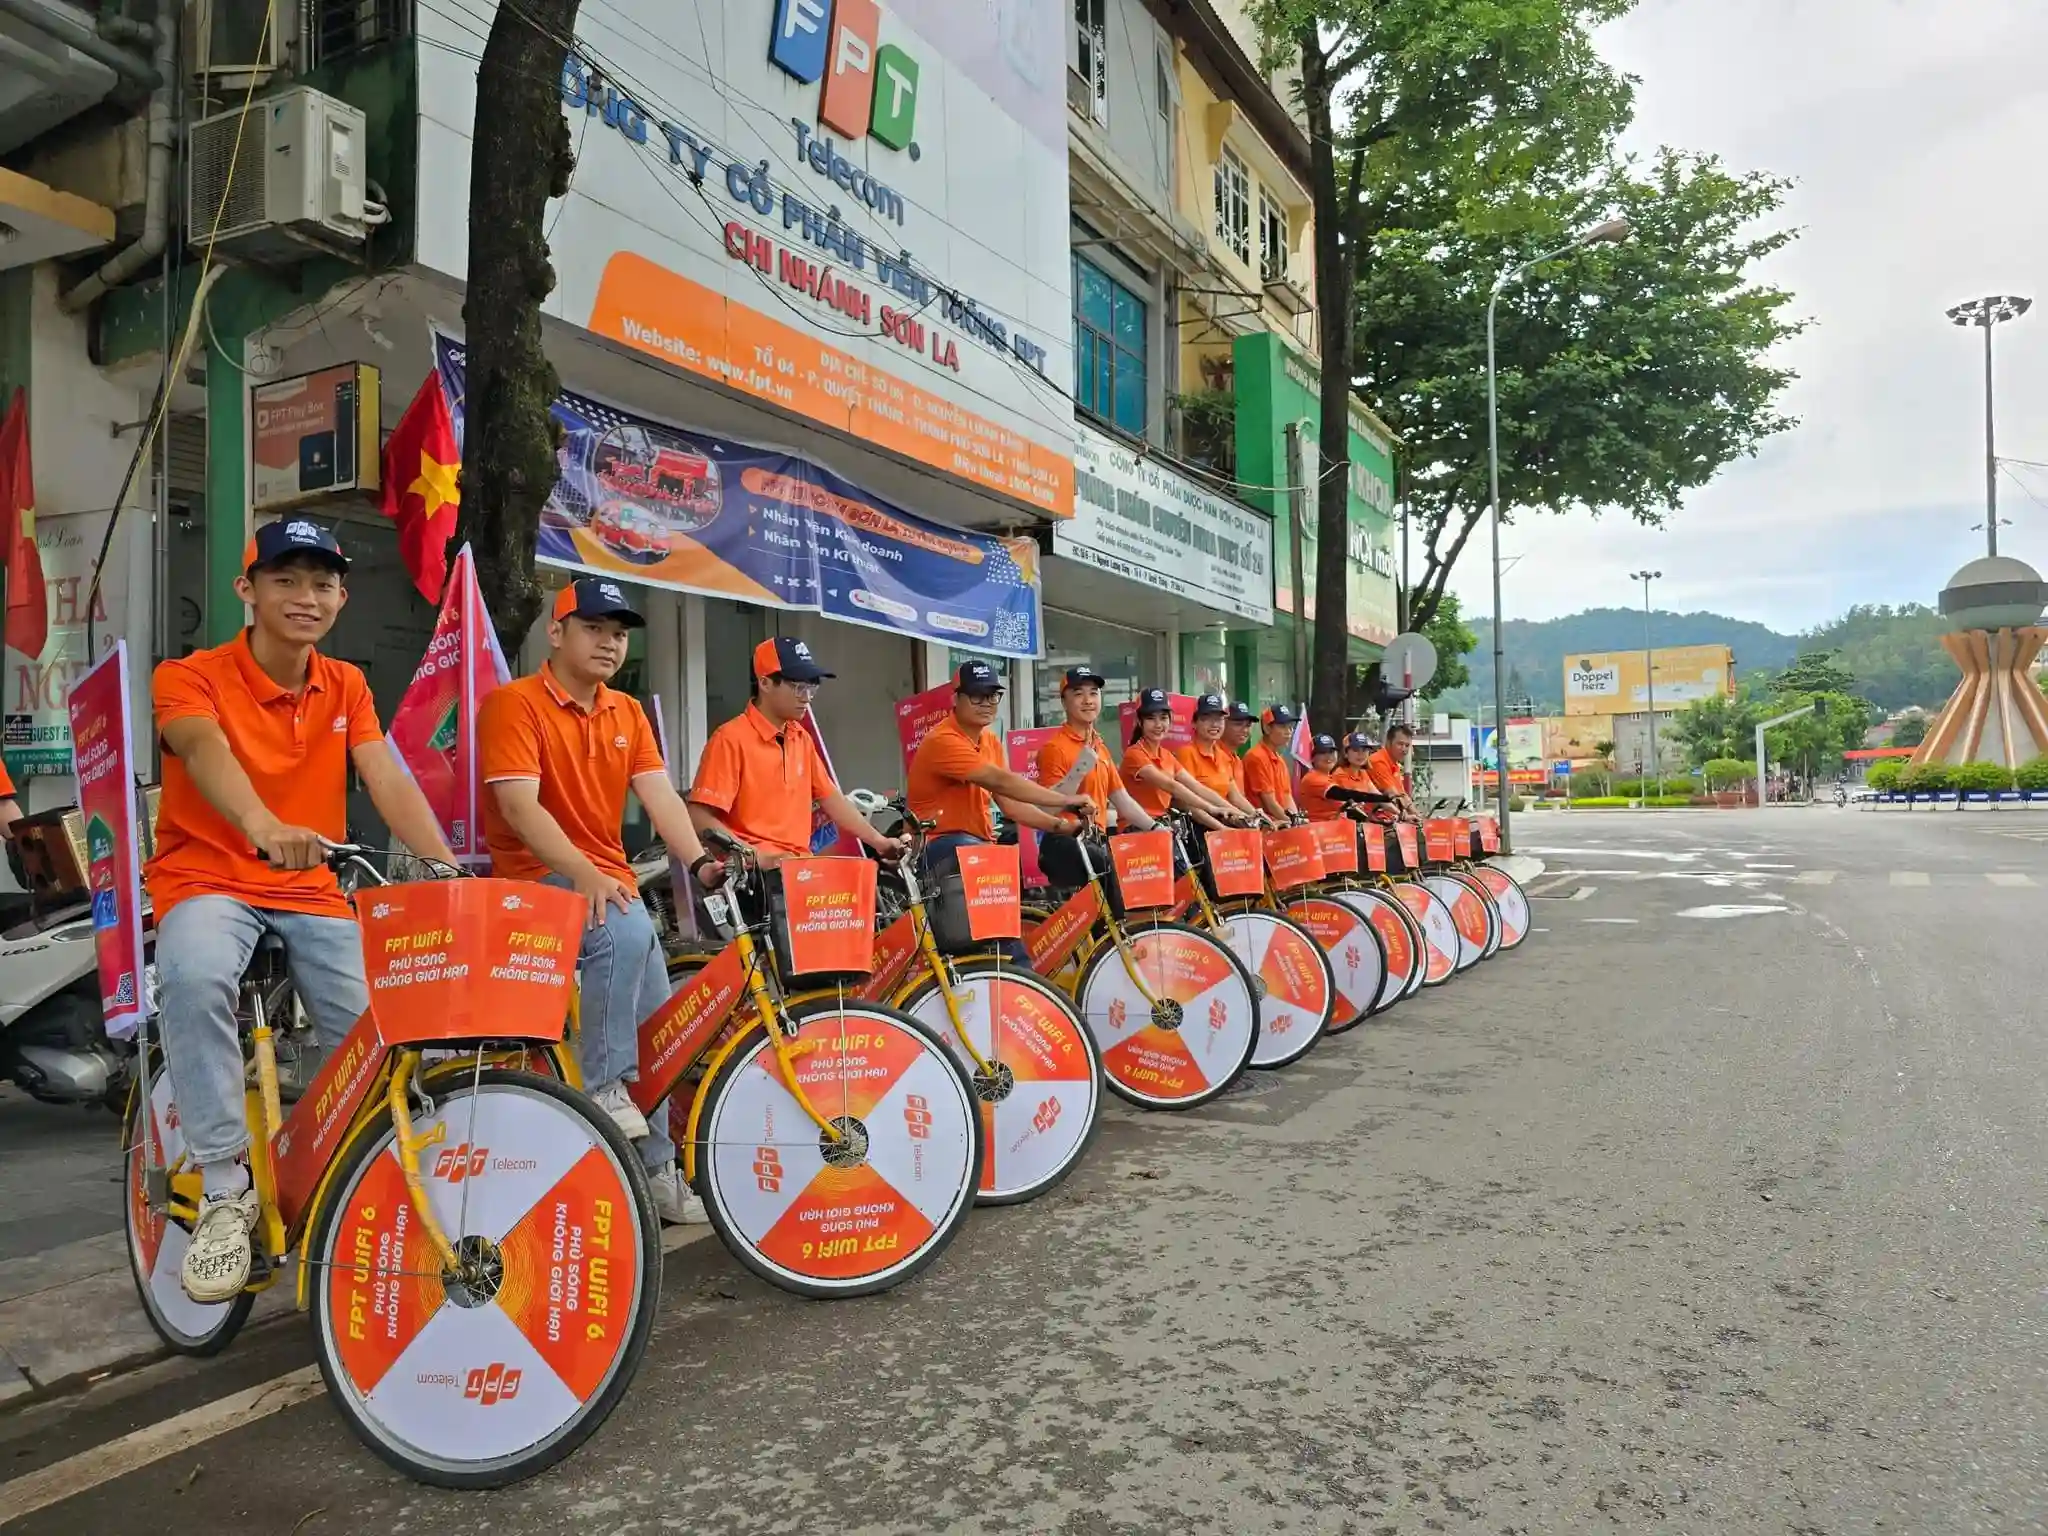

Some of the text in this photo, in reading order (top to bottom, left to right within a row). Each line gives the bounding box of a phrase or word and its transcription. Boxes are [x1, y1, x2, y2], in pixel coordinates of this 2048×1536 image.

[780, 0, 915, 125] FPT
[560, 51, 646, 145] ÔNG
[660, 121, 712, 179] TY
[726, 159, 773, 215] CỔ
[791, 117, 904, 226] Telecom
[725, 220, 960, 373] CHI NHÁNH SƠN LA
[621, 316, 794, 401] Website: www.fpt.vn
[764, 529, 801, 549] Nhân
[49, 559, 108, 625] HÀ
[1573, 671, 1613, 683] Doppel
[1581, 681, 1607, 691] herz
[805, 894, 825, 907] FPT
[808, 908, 828, 921] PHỦ
[385, 928, 453, 952] FPT WiFi 6
[795, 920, 827, 934] KHÔNG
[508, 931, 563, 953] FPT WiFi 6
[1032, 935, 1048, 957] FPT
[389, 951, 447, 971] PHỦ SÓNG
[508, 952, 557, 969] PHỦ SÓNG
[1203, 952, 1210, 964] 6
[374, 964, 469, 989] KHÔNG GIỚI HẠN
[490, 965, 528, 981] KHÔNG
[651, 982, 712, 1053] FPT WiFi 6
[1014, 994, 1072, 1054] FPT WiFi 6
[663, 1038, 682, 1060] SÓNG
[681, 1014, 704, 1043] KHÔNG
[832, 1034, 869, 1052] WiFi
[874, 1034, 885, 1049] 6
[810, 1056, 833, 1070] PHỦ
[864, 1067, 887, 1079] HẠN
[315, 1037, 365, 1122] FPT WiFi 6
[1160, 1074, 1185, 1089] FPT
[1036, 1099, 1059, 1131] FPT
[757, 1104, 779, 1192] FPT Telecom
[908, 1095, 928, 1182] FPT Telecom
[435, 1147, 536, 1176] FPT Telecom
[799, 1203, 895, 1222] KHÔNG GIỚI HẠN
[820, 1215, 879, 1233] PHỦ SÓNG
[802, 1232, 899, 1259] FPT WiFi 6
[350, 1205, 376, 1340] FPT WiFi 6
[374, 1232, 391, 1317] PHỦ SÓNG
[387, 1279, 401, 1339] KHÔNG
[396, 1204, 408, 1234] HẠN
[548, 1202, 568, 1342] KHÔNG GIỚI HẠN
[566, 1226, 582, 1311] PHỦ SÓNG
[586, 1199, 612, 1342] FPT WiFi 6
[417, 1369, 520, 1399] FPT Telecom
